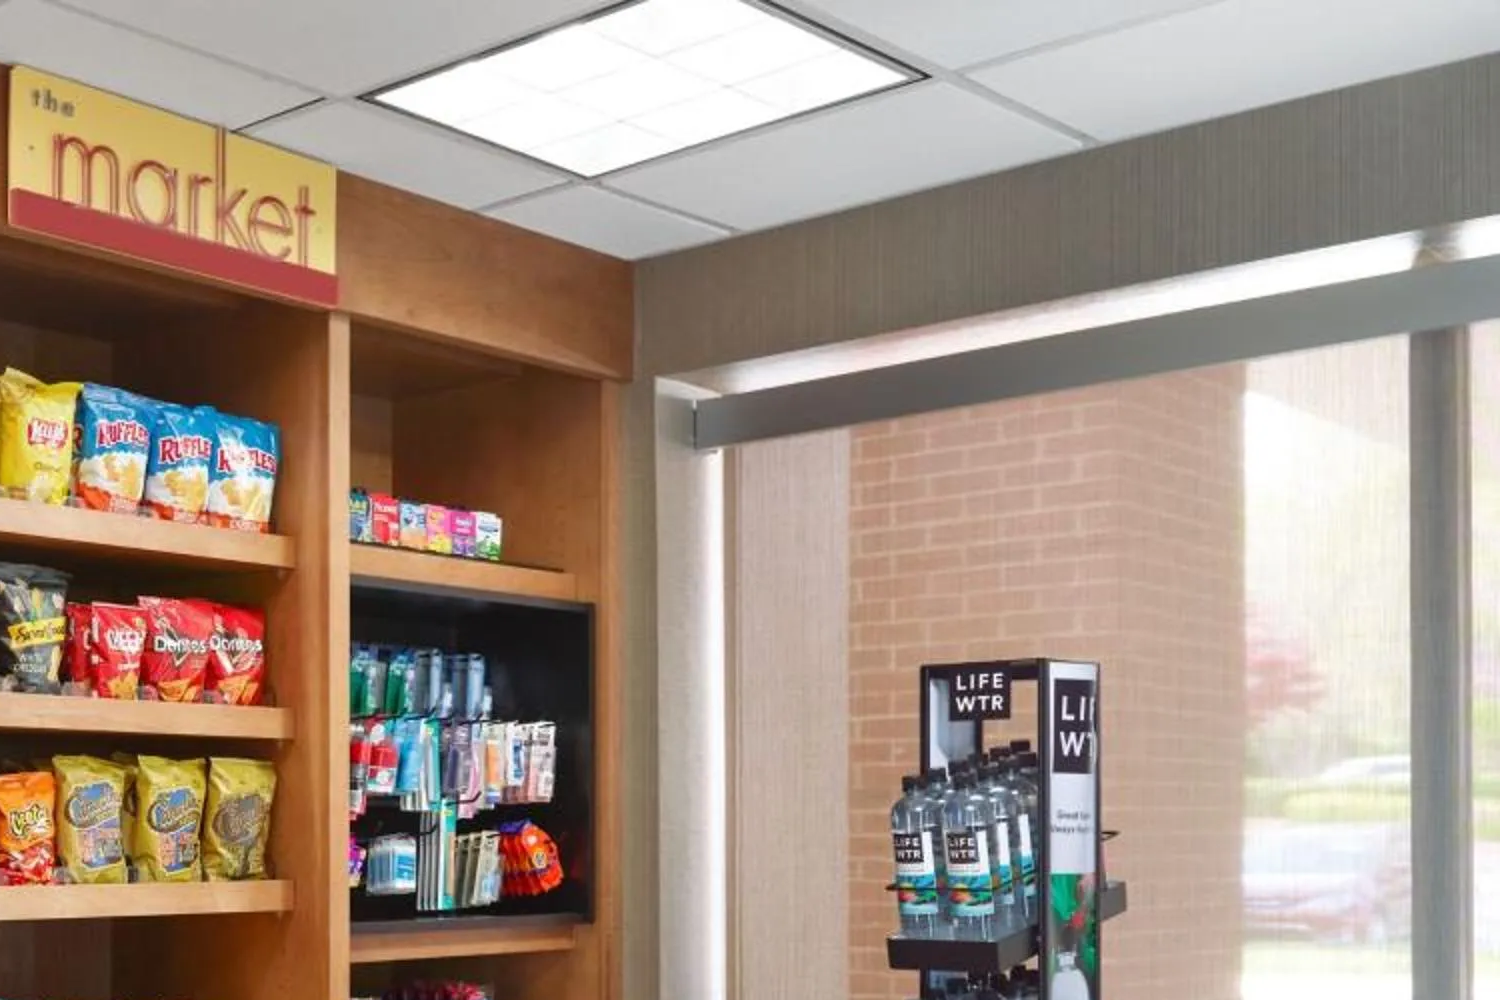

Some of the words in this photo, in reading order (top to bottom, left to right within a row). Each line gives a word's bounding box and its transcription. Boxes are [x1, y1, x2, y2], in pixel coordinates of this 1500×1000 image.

[30, 89, 76, 117] the
[52, 126, 316, 269] market
[155, 635, 206, 653] Doritos
[956, 673, 1004, 691] LIFE
[956, 695, 1004, 712] WTR
